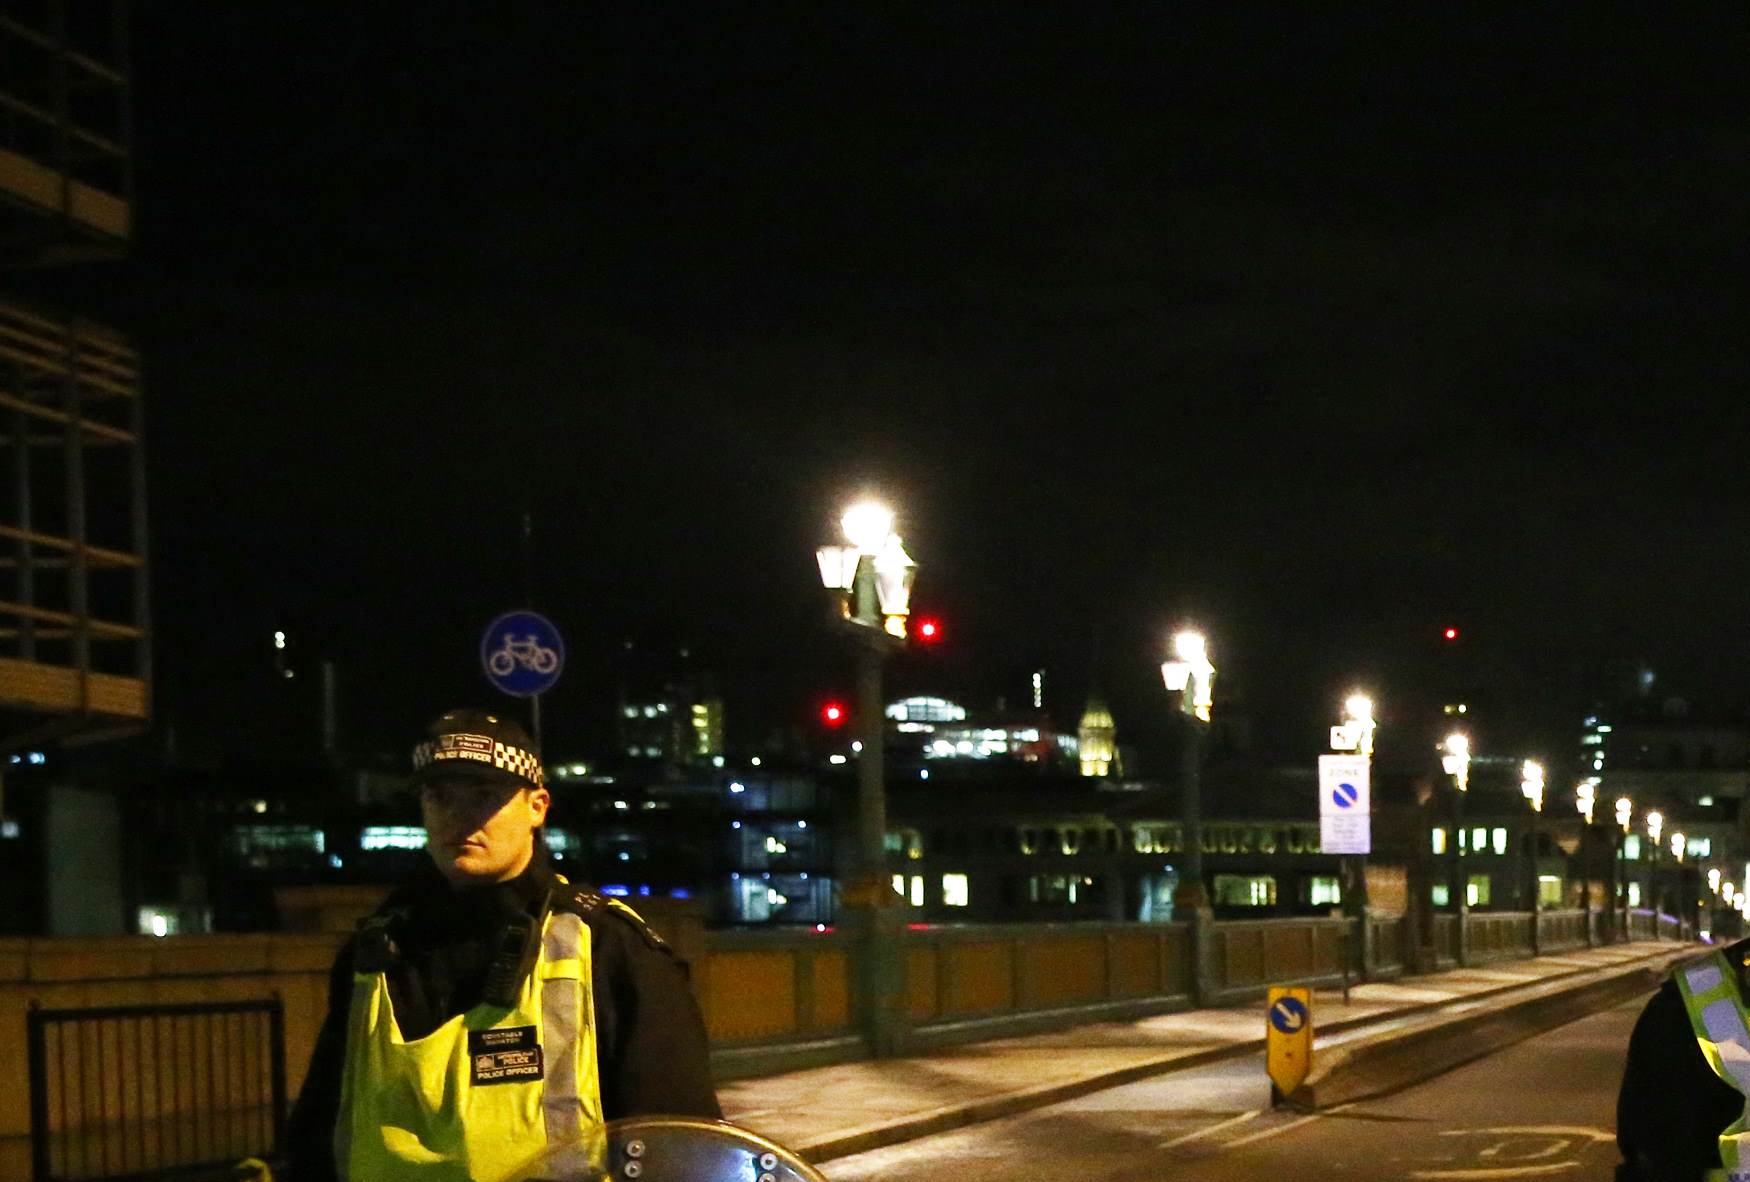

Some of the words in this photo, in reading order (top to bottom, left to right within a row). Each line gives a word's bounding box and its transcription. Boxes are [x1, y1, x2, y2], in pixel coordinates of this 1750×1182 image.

[459, 750, 491, 763] OFFICER
[503, 1055, 529, 1065] POLICE
[478, 1070, 504, 1080] POLICE
[505, 1066, 539, 1076] OFFICER
